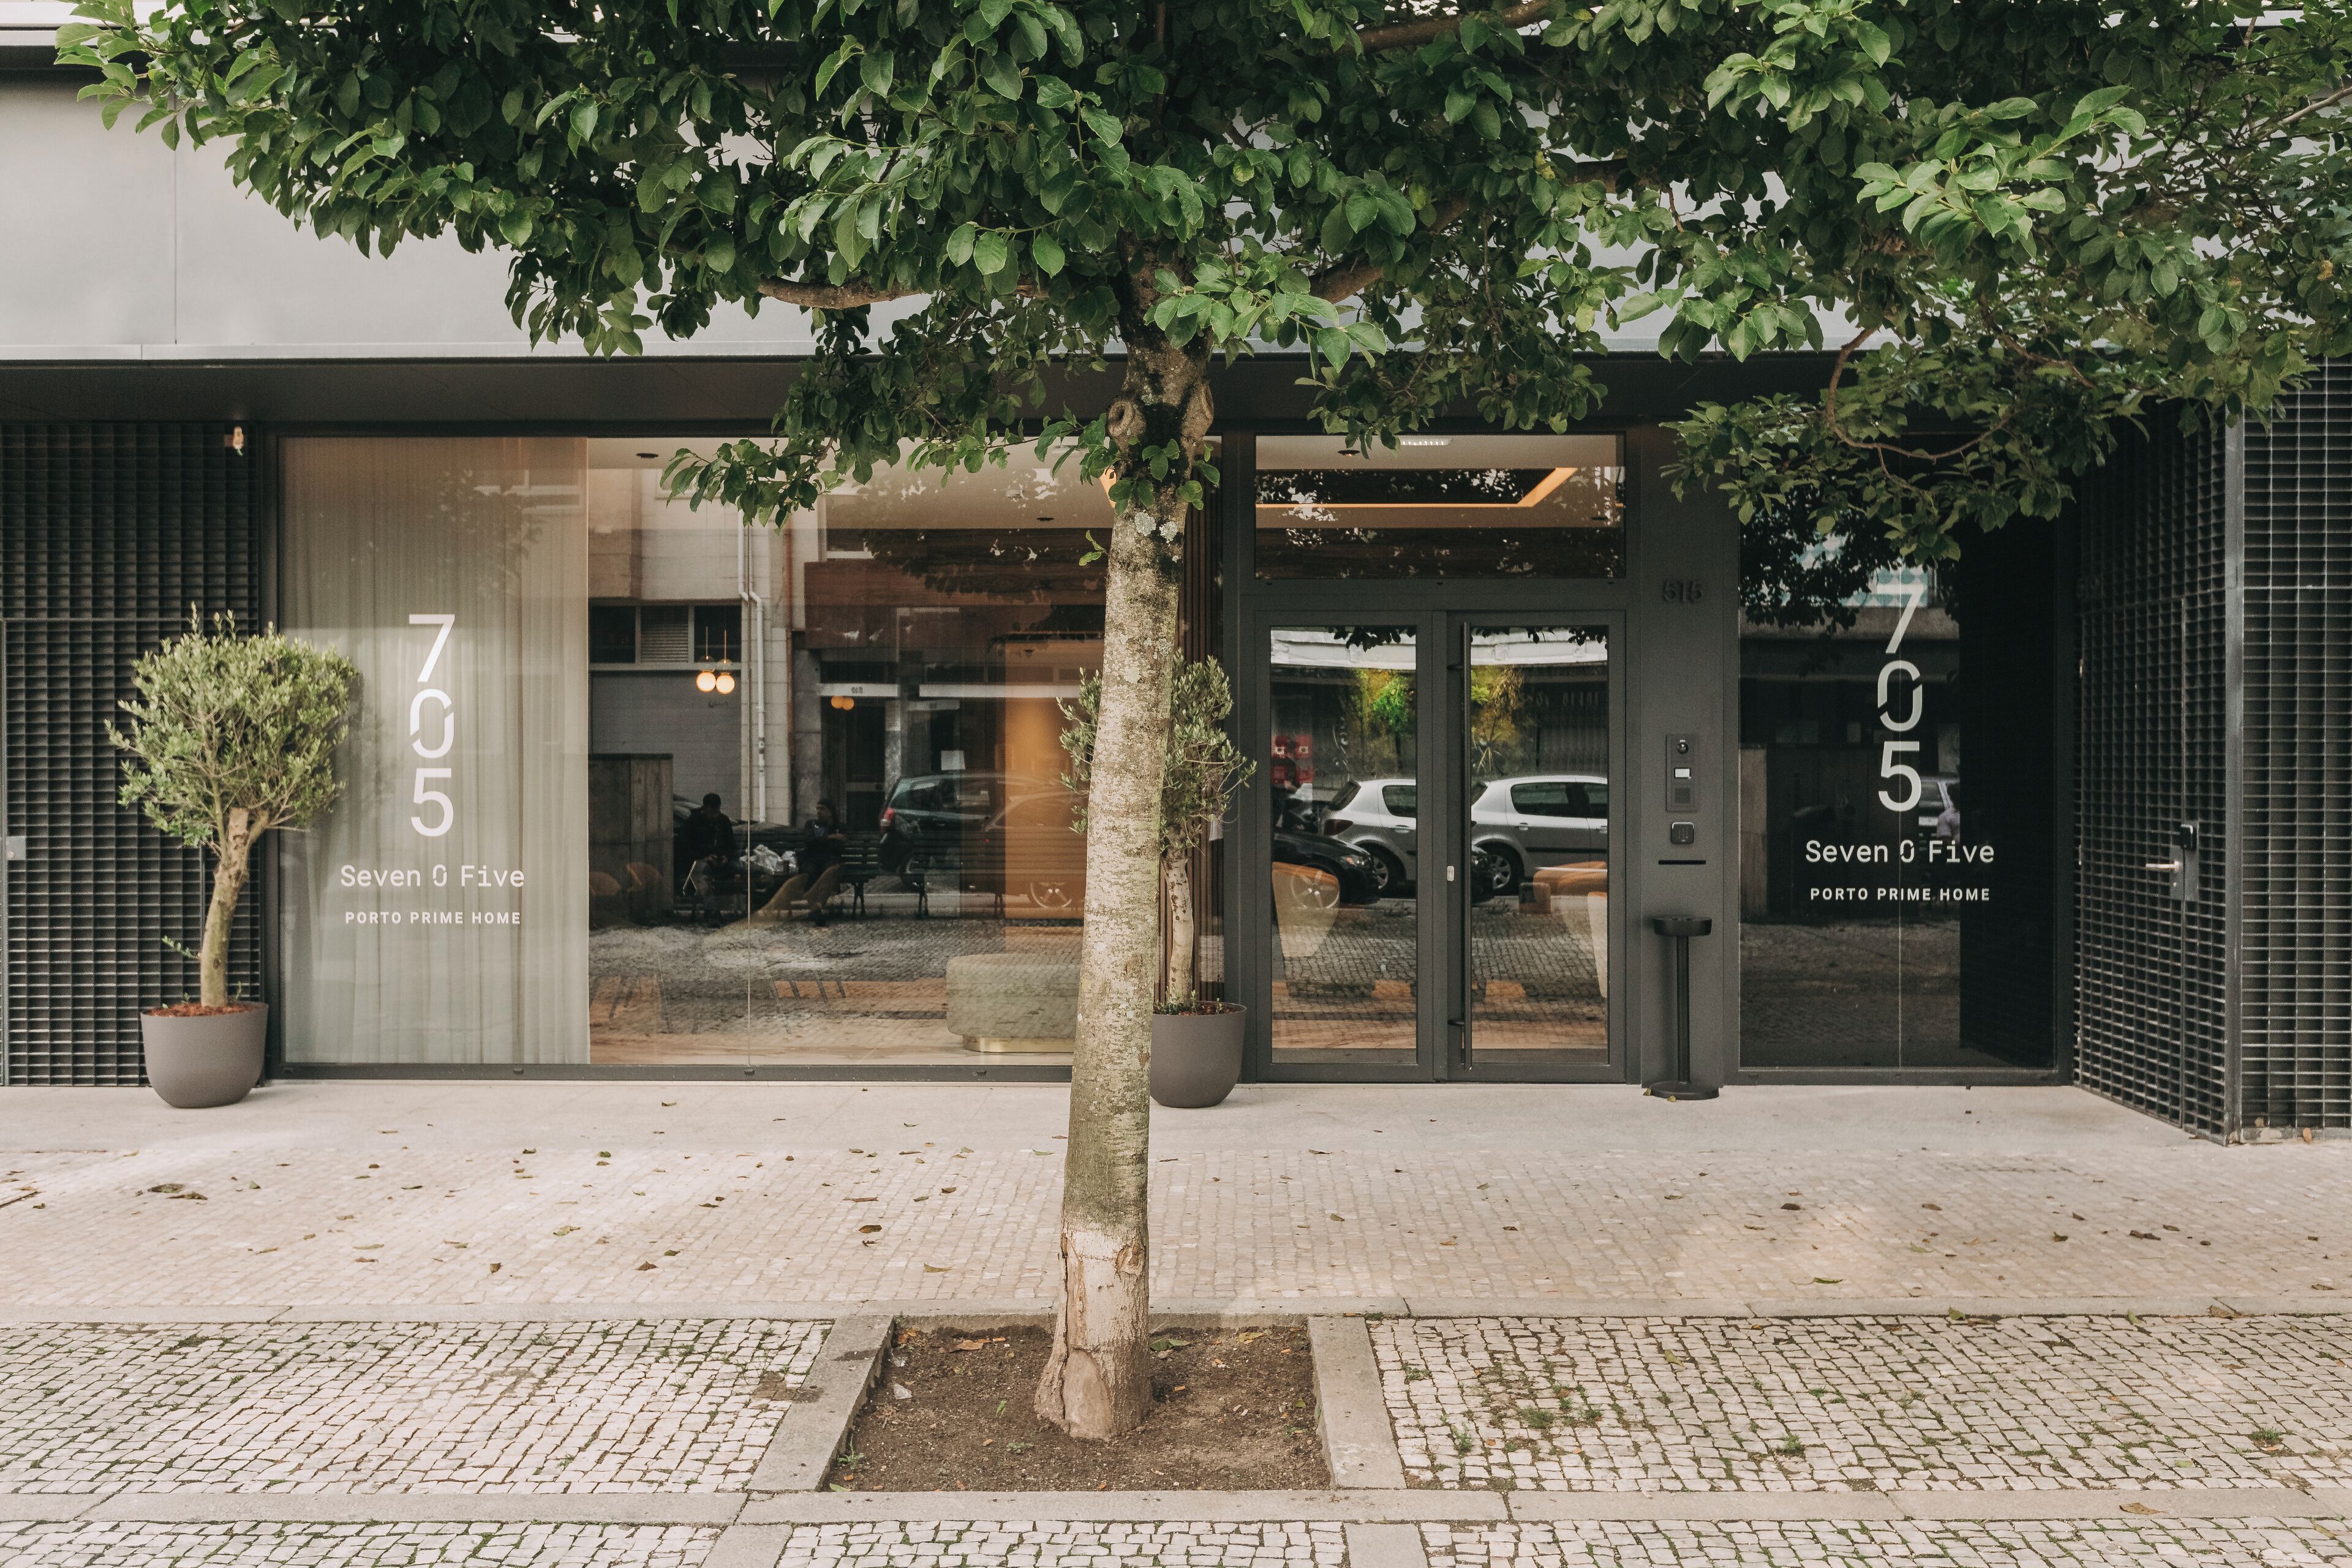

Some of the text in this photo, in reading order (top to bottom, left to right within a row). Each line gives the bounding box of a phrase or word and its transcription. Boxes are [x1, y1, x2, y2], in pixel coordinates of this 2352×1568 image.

[1876, 583, 1924, 812] 705
[409, 614, 455, 837] 705
[1805, 839, 1888, 864] Seven
[1928, 840, 1995, 864] Five
[340, 863, 421, 888] Seven
[461, 864, 525, 888] Five
[1810, 888, 1990, 902] PORTO PRIME HOME
[345, 911, 521, 924] PORTO PRIME HOME
